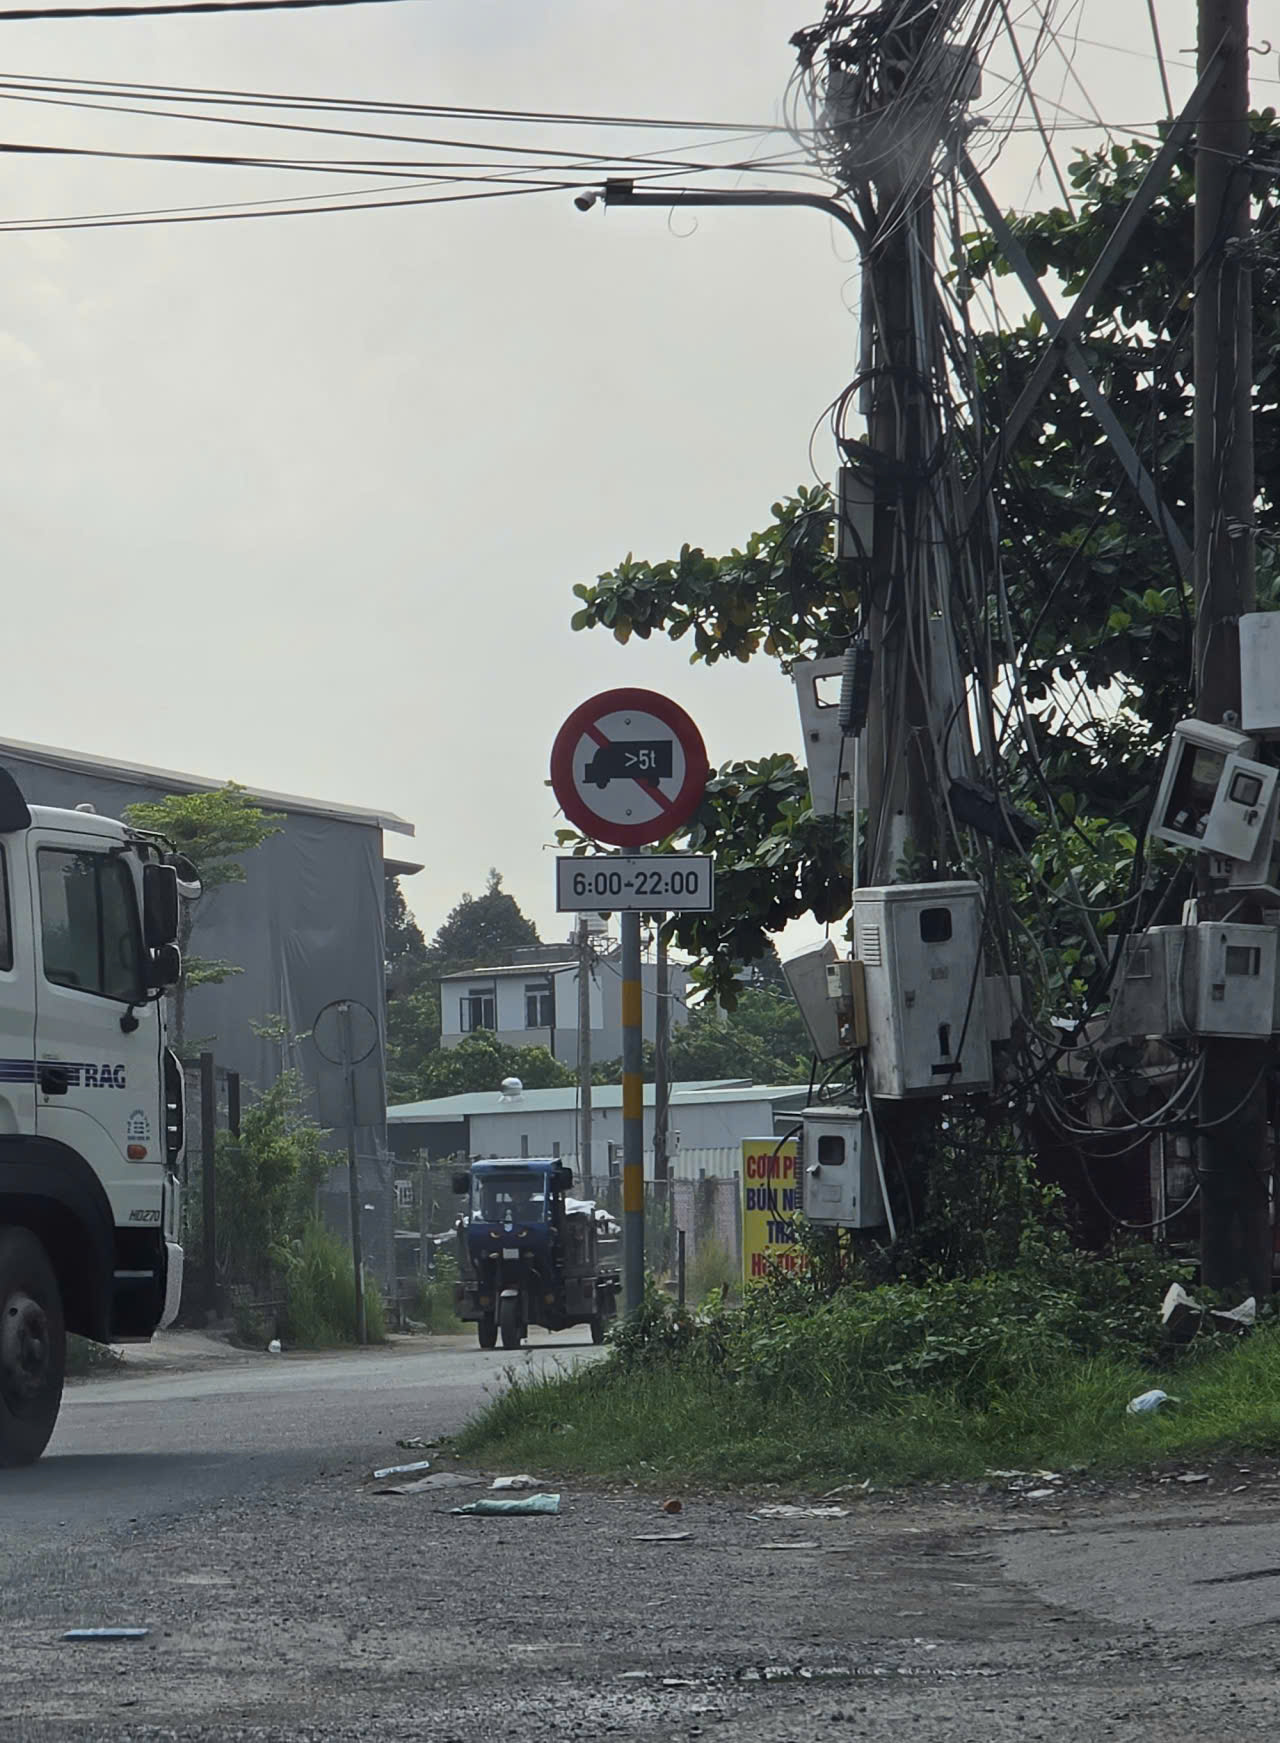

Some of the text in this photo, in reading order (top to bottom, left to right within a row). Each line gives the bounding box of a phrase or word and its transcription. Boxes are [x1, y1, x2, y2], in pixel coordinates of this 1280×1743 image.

[624, 750, 656, 770] >5t
[573, 871, 699, 896] 6:00-22:00
[746, 1153, 780, 1179] CƠM
[746, 1183, 778, 1211] BÚN
[128, 1210, 160, 1222] HD270
